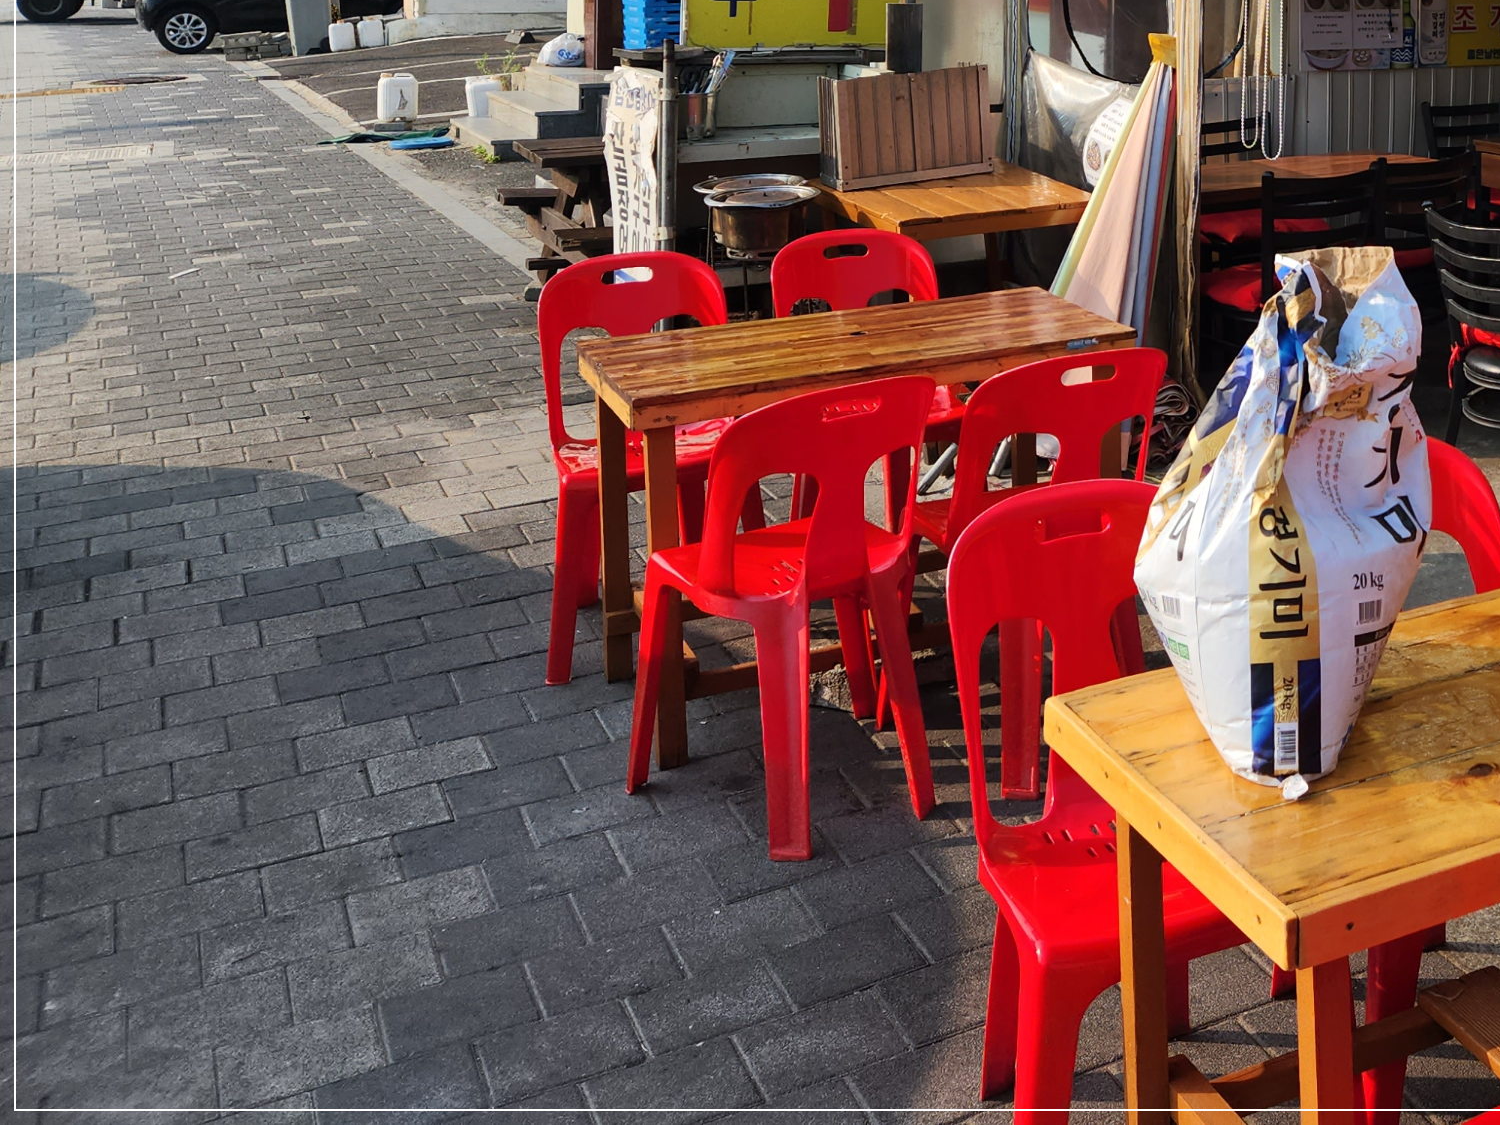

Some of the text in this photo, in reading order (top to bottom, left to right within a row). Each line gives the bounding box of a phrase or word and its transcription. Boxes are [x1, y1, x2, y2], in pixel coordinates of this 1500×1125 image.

[1259, 506, 1310, 640] 경기미
[1353, 571, 1384, 591] 20 kg
[1281, 676, 1295, 710] 20 kg
